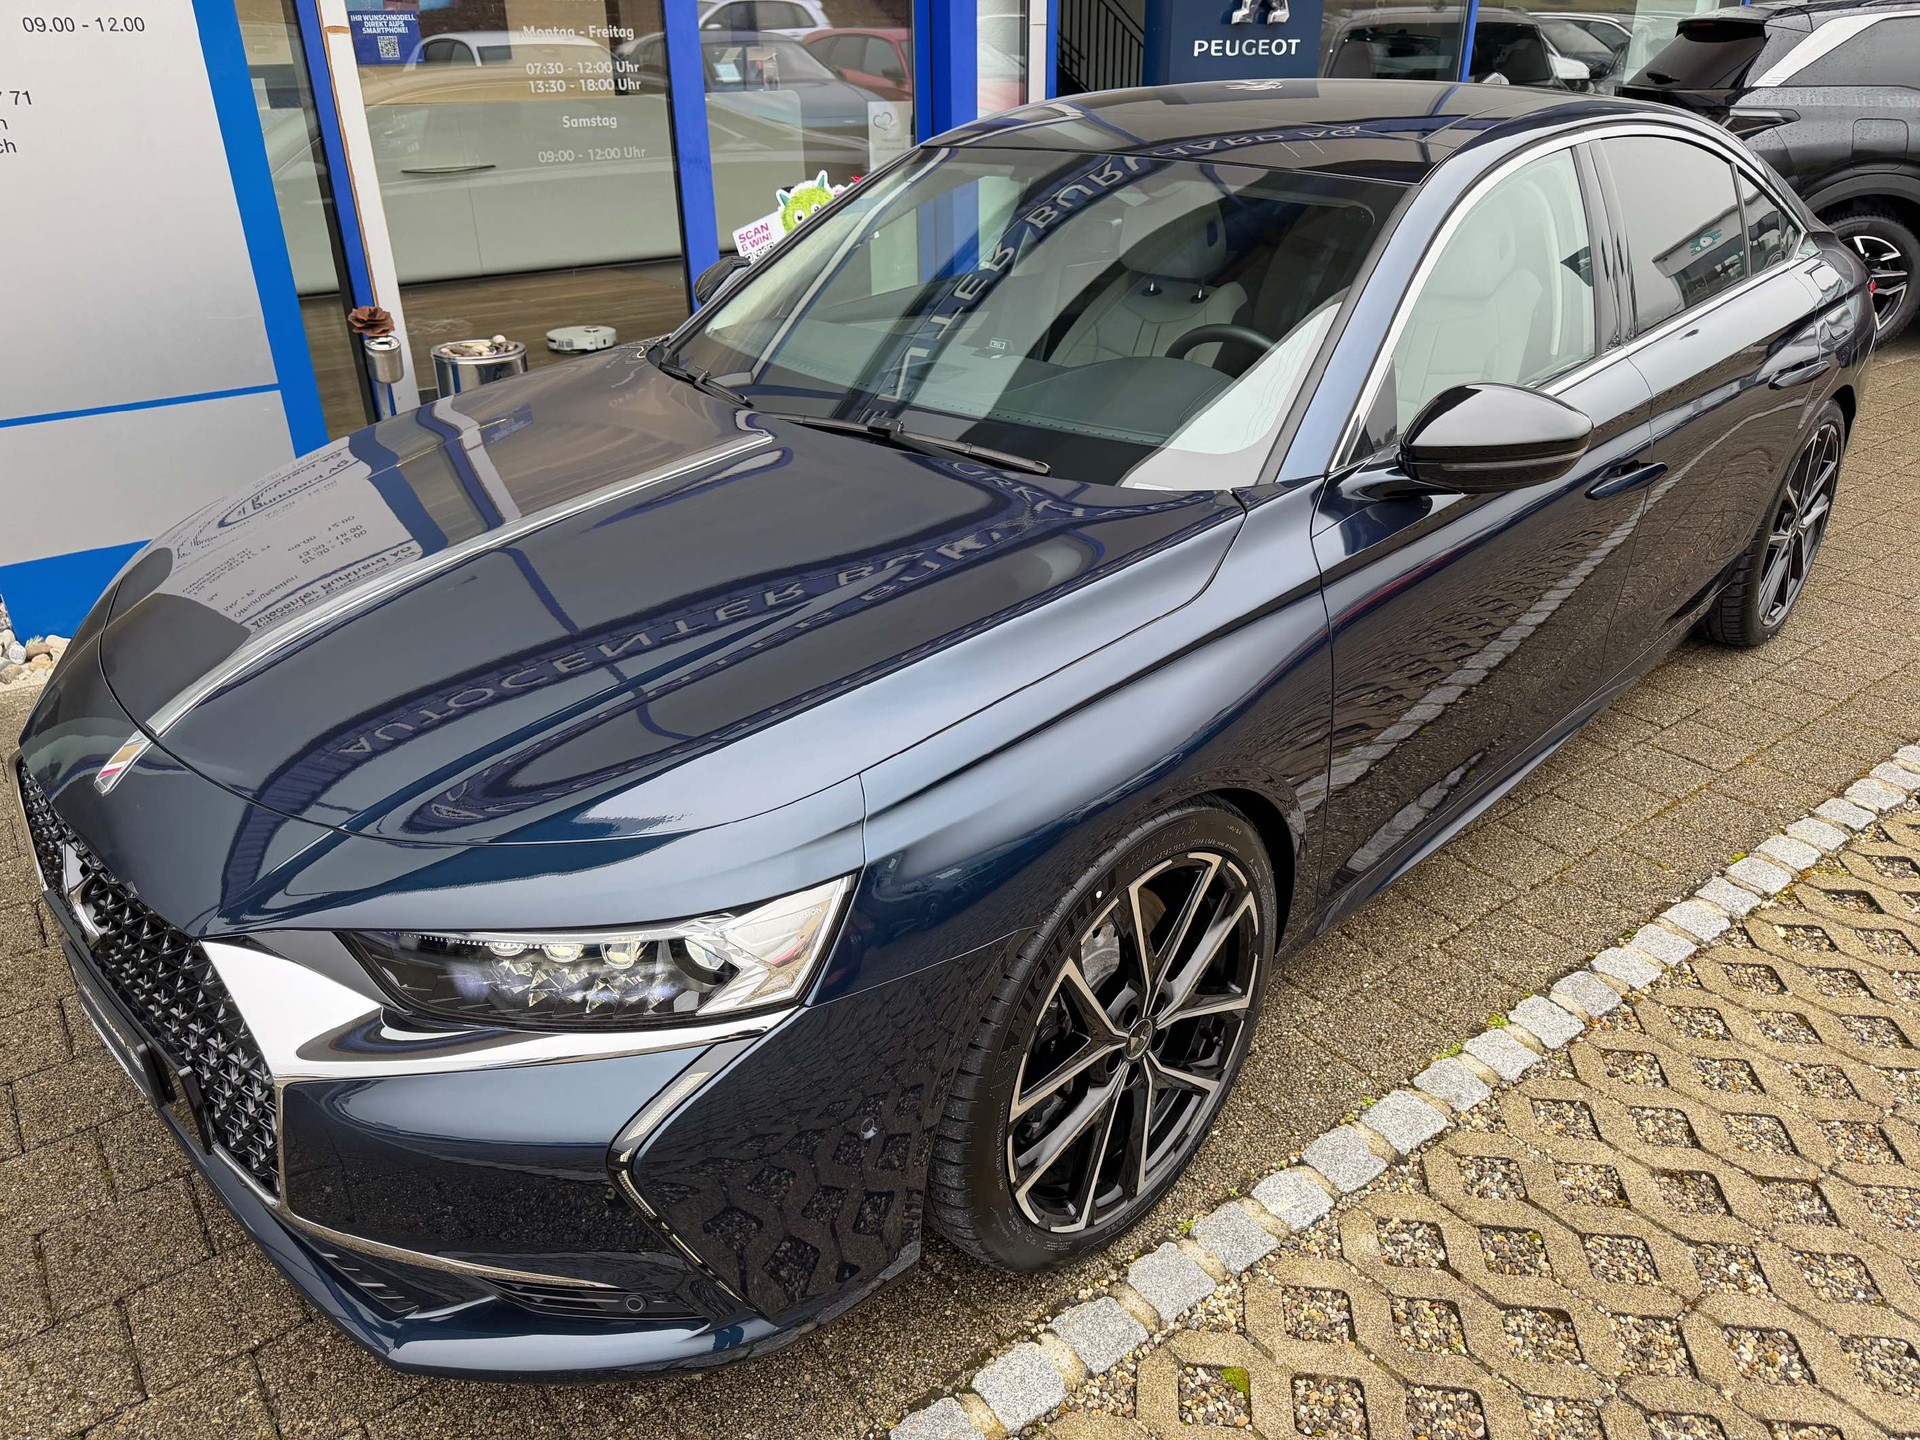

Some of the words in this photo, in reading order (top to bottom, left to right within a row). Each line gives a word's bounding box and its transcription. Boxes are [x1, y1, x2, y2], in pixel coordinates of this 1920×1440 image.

[22, 16, 75, 33] 09.00
[95, 16, 146, 33] 12.00
[350, 14, 363, 22] IHR
[362, 13, 416, 22] WUNSCHMODELL
[362, 26, 409, 35] SMARTPHONE!
[522, 25, 575, 41] Montag
[588, 25, 635, 41] Freitag
[1192, 37, 1302, 58] PEUGEOT
[526, 62, 564, 75] 07:30
[578, 62, 613, 74] 12:00
[617, 61, 640, 74] Uhr
[528, 79, 566, 93] 13:30
[580, 78, 614, 92] 18:00
[618, 78, 642, 91] Uhr
[562, 115, 618, 129] Samstag
[538, 149, 575, 163] 09:00
[588, 148, 621, 160] 12:00
[624, 147, 646, 159] Uhr
[738, 222, 770, 244] SCAN
[741, 243, 749, 253] &
[749, 232, 772, 249] WIN!
